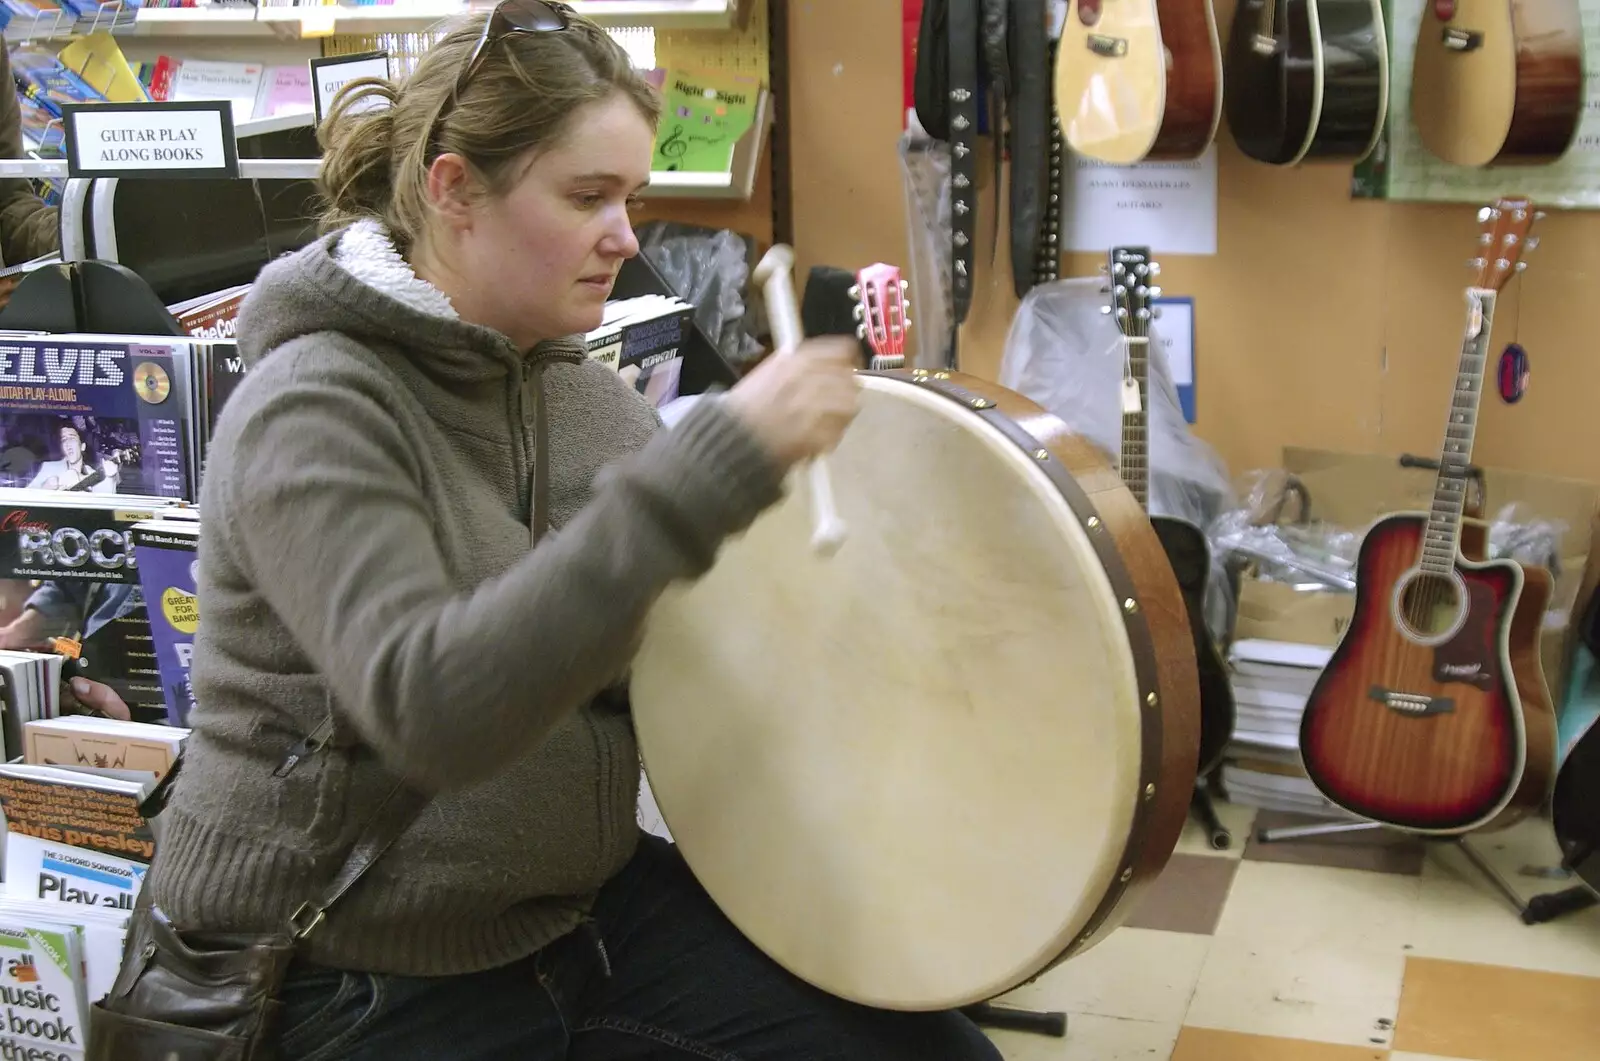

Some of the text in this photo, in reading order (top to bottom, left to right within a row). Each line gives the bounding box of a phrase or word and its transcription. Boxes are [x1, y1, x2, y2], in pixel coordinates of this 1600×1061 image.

[100, 128, 197, 142] GUITAR PLAY
[100, 147, 204, 161] ALONG BOOKS
[0, 346, 125, 386] ELVIS
[25, 387, 77, 402] PLAY-ALONG
[141, 533, 155, 541] Full
[155, 535, 173, 543] Band
[168, 596, 195, 606] GREAT
[175, 605, 194, 613] FOR
[8, 820, 155, 858] elvis presley
[43, 850, 57, 859] THE
[64, 855, 91, 867] CHORD
[91, 861, 134, 877] SONGBOOK
[38, 872, 135, 911] Play all
[8, 1007, 77, 1045] book
